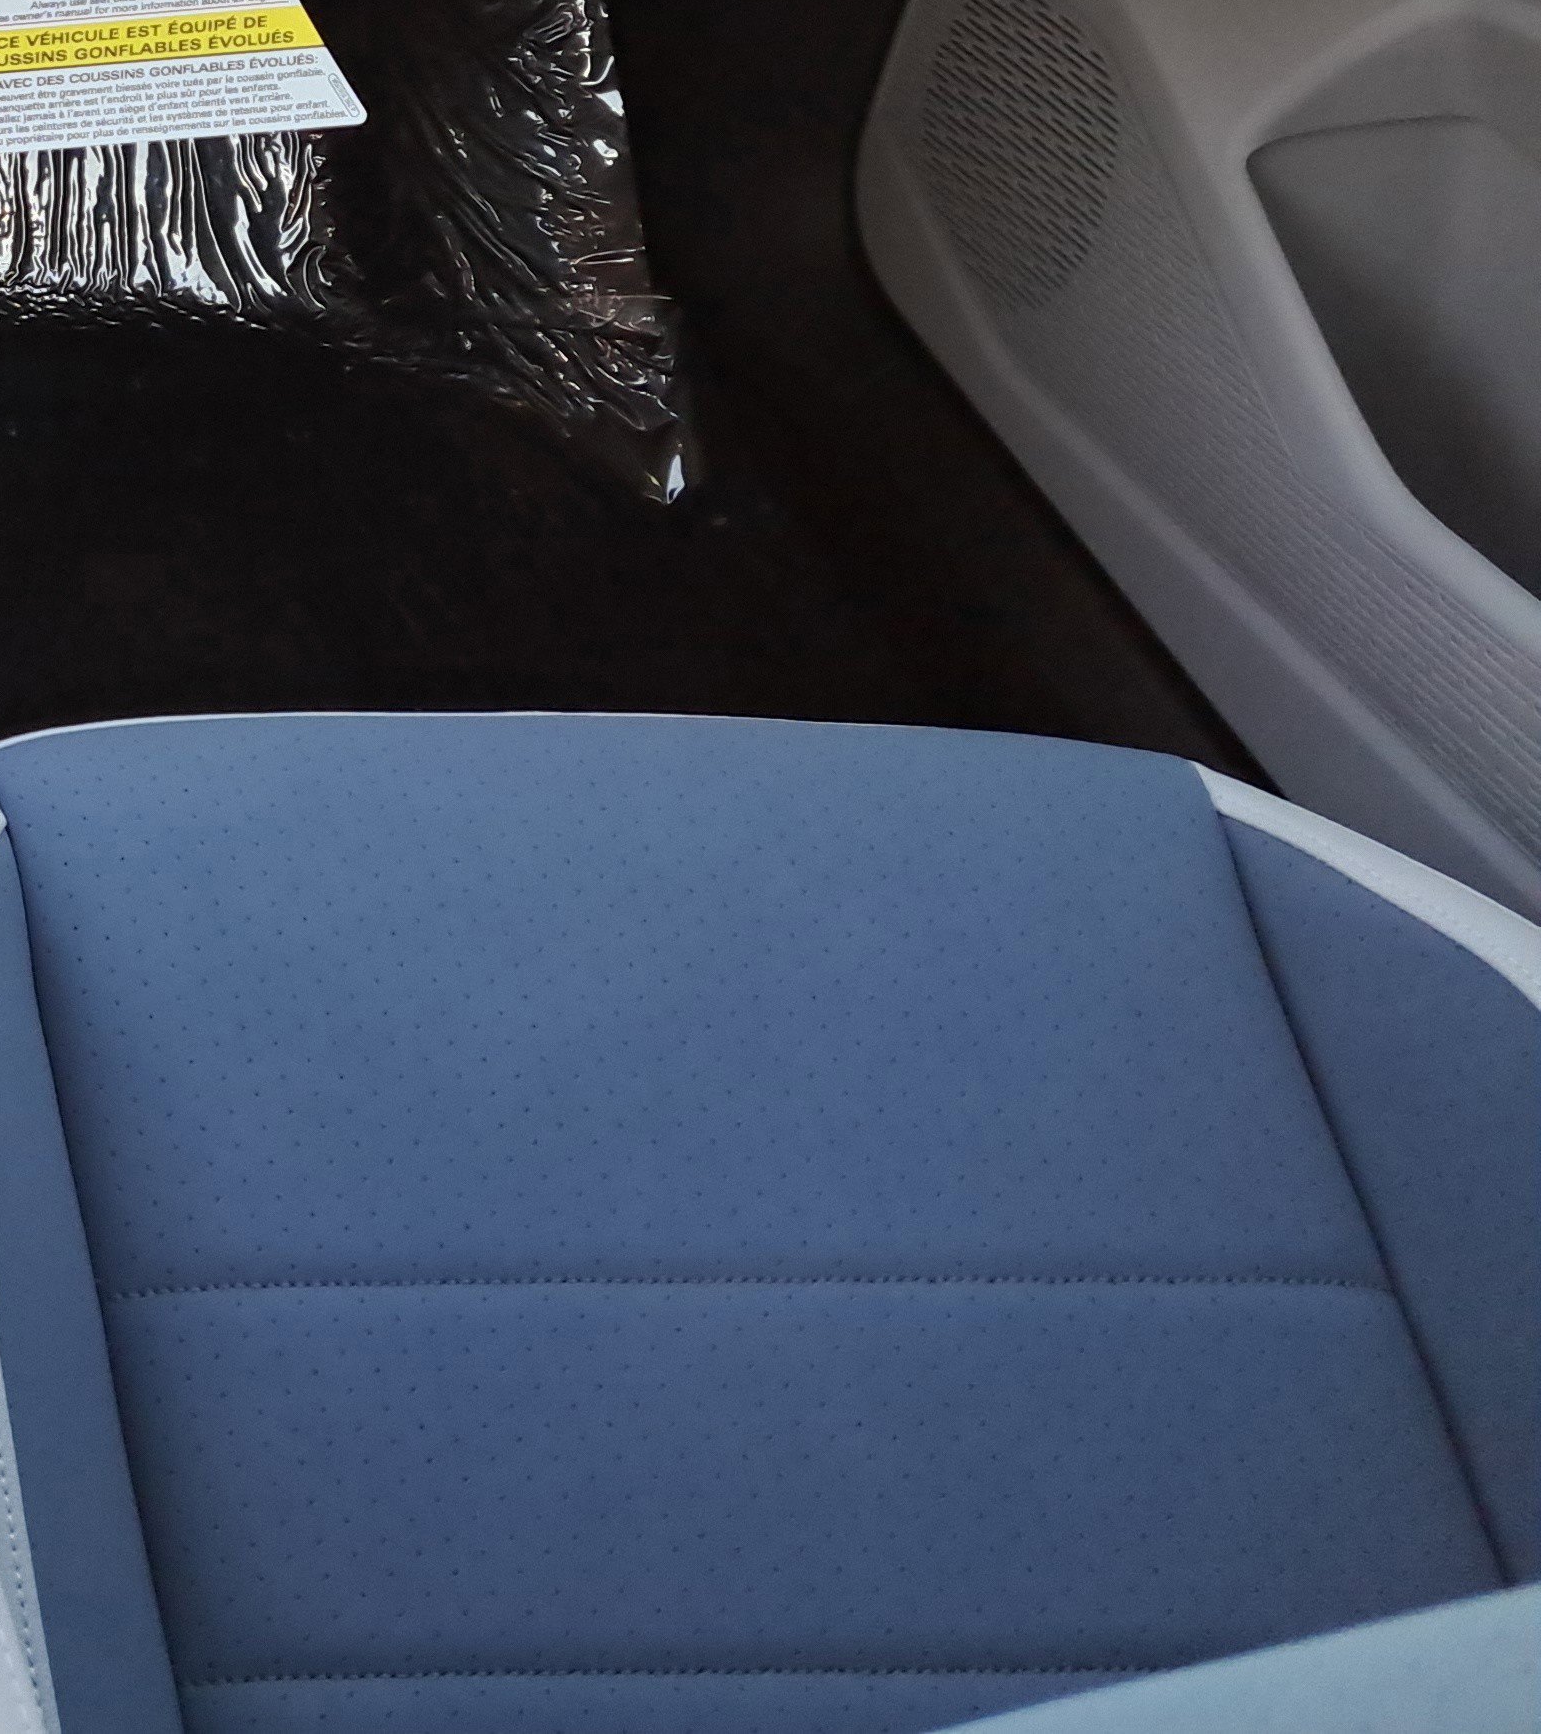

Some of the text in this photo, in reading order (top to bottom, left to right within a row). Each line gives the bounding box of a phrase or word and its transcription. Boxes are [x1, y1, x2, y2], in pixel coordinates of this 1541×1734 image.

[26, 27, 120, 47] VÉHICULE
[126, 24, 162, 39] EST
[167, 15, 237, 36] ÉQUIPÉ
[243, 15, 267, 29] DE
[73, 37, 202, 61] GONFLABLES
[208, 28, 295, 50] ÉVOLUÉS
[36, 74, 65, 87] DES
[69, 68, 145, 84] COUSSINS
[148, 57, 245, 78] GONFLABLES
